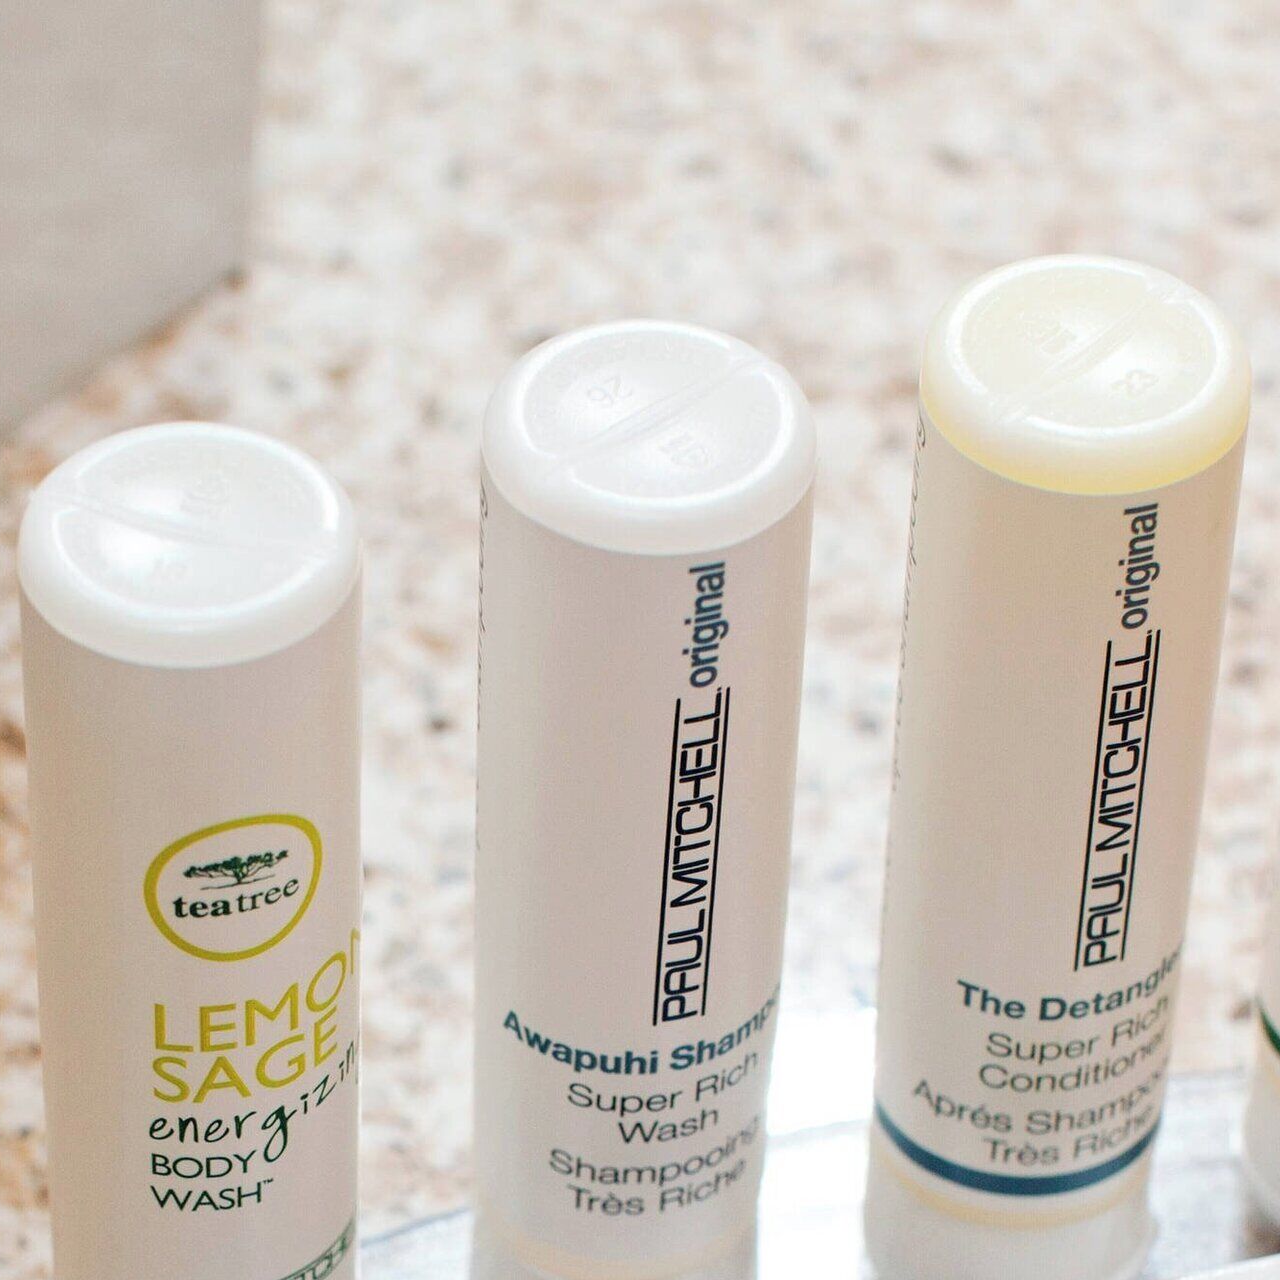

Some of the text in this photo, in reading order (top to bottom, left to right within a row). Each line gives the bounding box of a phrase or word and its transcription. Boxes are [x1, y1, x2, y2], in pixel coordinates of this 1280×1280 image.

[1116, 501, 1161, 630] original
[684, 560, 729, 689] original
[1083, 852, 1129, 967] PAUL
[662, 908, 705, 1022] PAUL
[957, 979, 1026, 1021] The
[986, 995, 1168, 1065] Super Rich
[152, 1006, 338, 1104] SAGE
[502, 1010, 660, 1077] Awapuhi
[567, 1052, 758, 1117] Super Rich
[618, 1106, 719, 1144] Wash
[151, 1150, 258, 1179] BODY
[567, 1185, 644, 1216] Très
